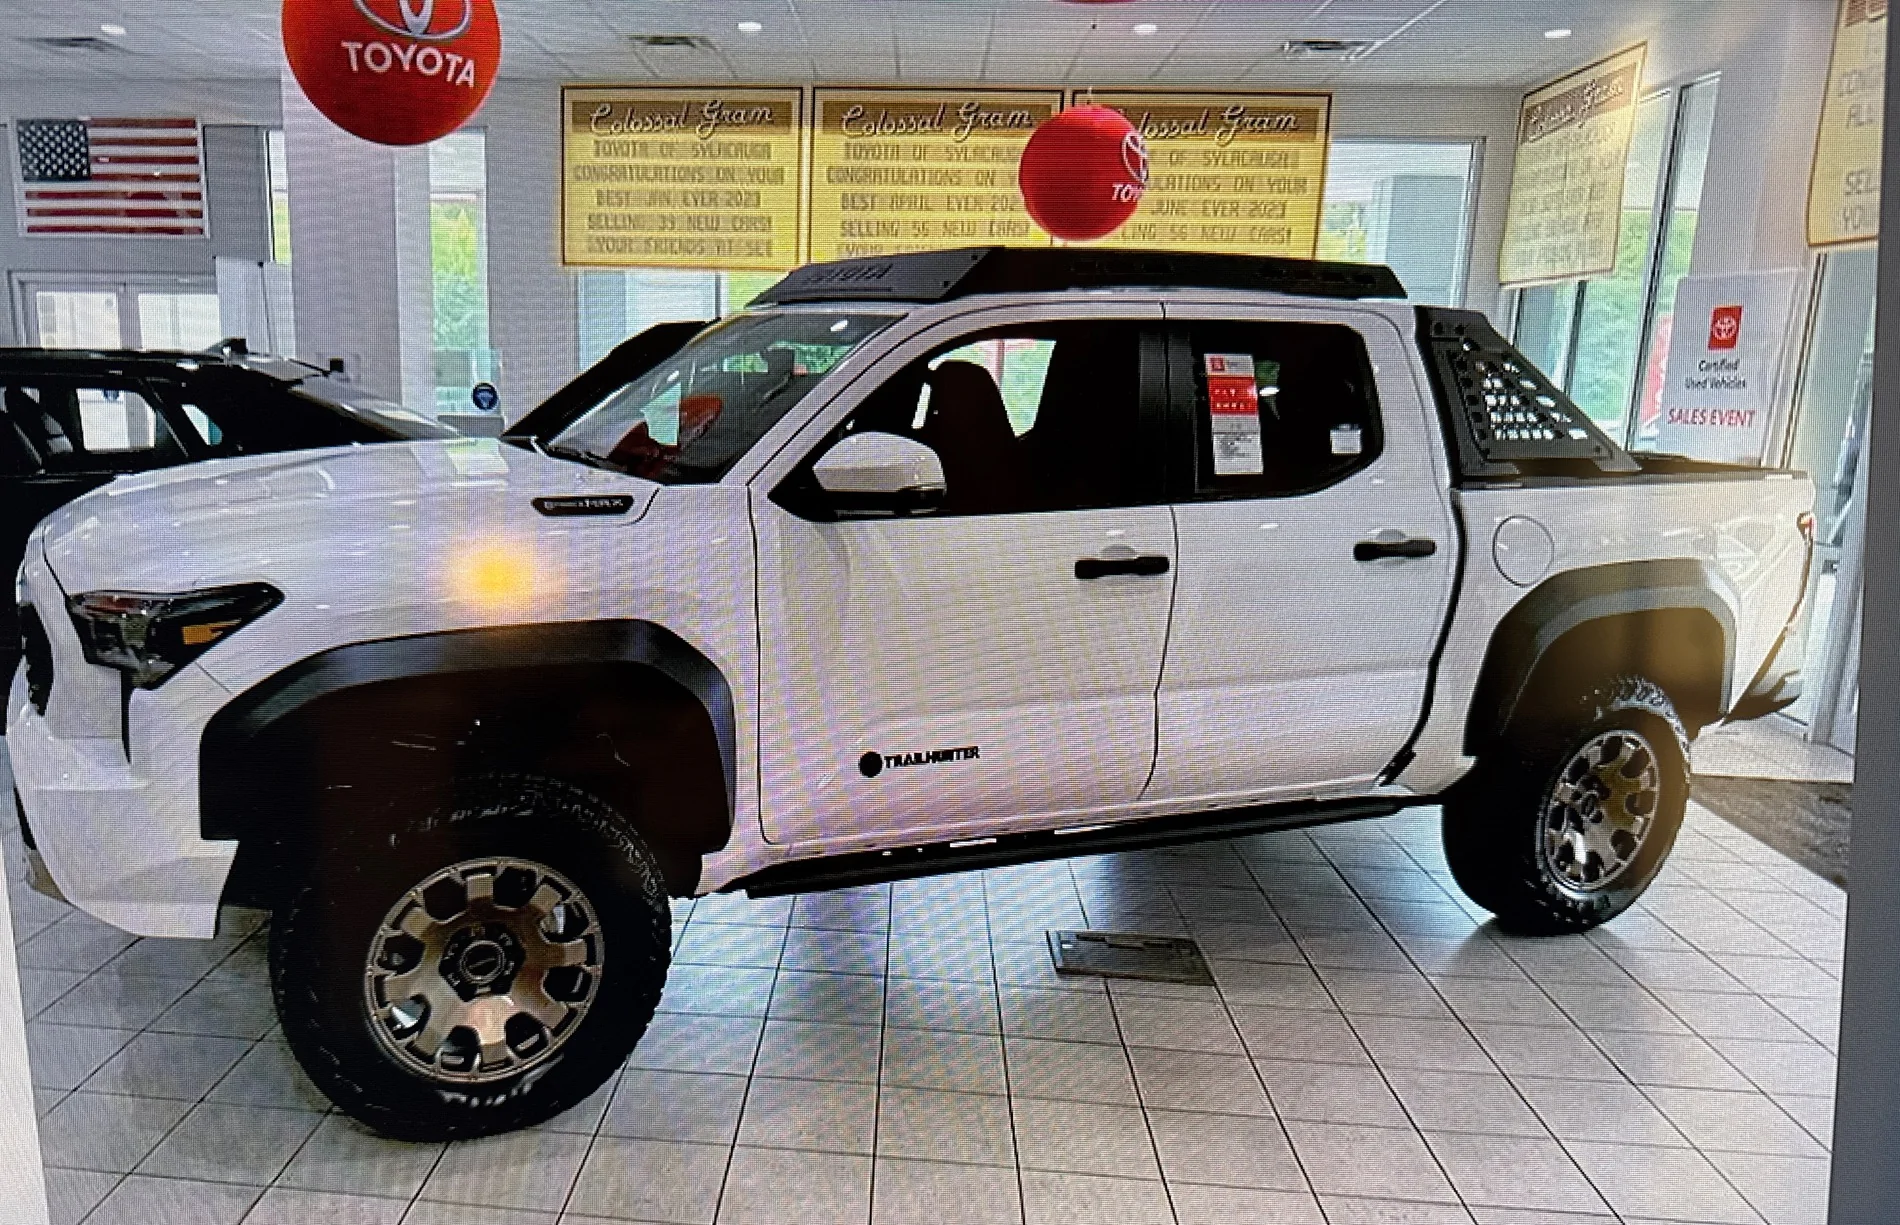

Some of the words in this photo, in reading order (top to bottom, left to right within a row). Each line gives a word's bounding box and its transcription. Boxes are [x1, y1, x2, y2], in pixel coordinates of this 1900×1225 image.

[341, 40, 475, 88] TOYOTA
[590, 103, 690, 136] Colossal
[695, 99, 774, 139] Gram
[841, 102, 946, 137] Colossal
[952, 101, 1035, 142] Gram
[1138, 108, 1210, 139] lossal
[1214, 104, 1300, 147] Gram
[594, 140, 649, 158] TOYOTA
[659, 141, 675, 157] OF
[844, 142, 900, 160] TOYOTA
[912, 143, 929, 160] OF
[1169, 150, 1188, 167] OF
[573, 165, 705, 184] CONGRATULATIONS
[716, 166, 737, 183] ON
[747, 166, 785, 185] YOUR
[826, 166, 963, 185] CONGRATULATIONS
[975, 168, 996, 185] ON
[1233, 176, 1255, 194] ON
[1267, 176, 1308, 195] YOUR
[596, 189, 631, 207] BEST
[682, 191, 718, 208] EVER
[840, 193, 878, 210] BEST
[889, 193, 934, 211] APRIL
[945, 194, 983, 211] EVER
[990, 195, 1019, 212] 202
[1150, 199, 1188, 216] JUNE
[1201, 200, 1240, 218] EVER
[1247, 201, 1287, 219] 2023
[587, 213, 644, 231] SELLING
[687, 214, 720, 232] NEW
[840, 220, 900, 238] SELLING
[942, 221, 977, 238] NEW
[1201, 224, 1237, 242] NEW
[1698, 358, 1741, 373] Certified
[1685, 376, 1708, 390] Used
[1667, 408, 1707, 425] SALES
[1710, 409, 1756, 427] EVENT
